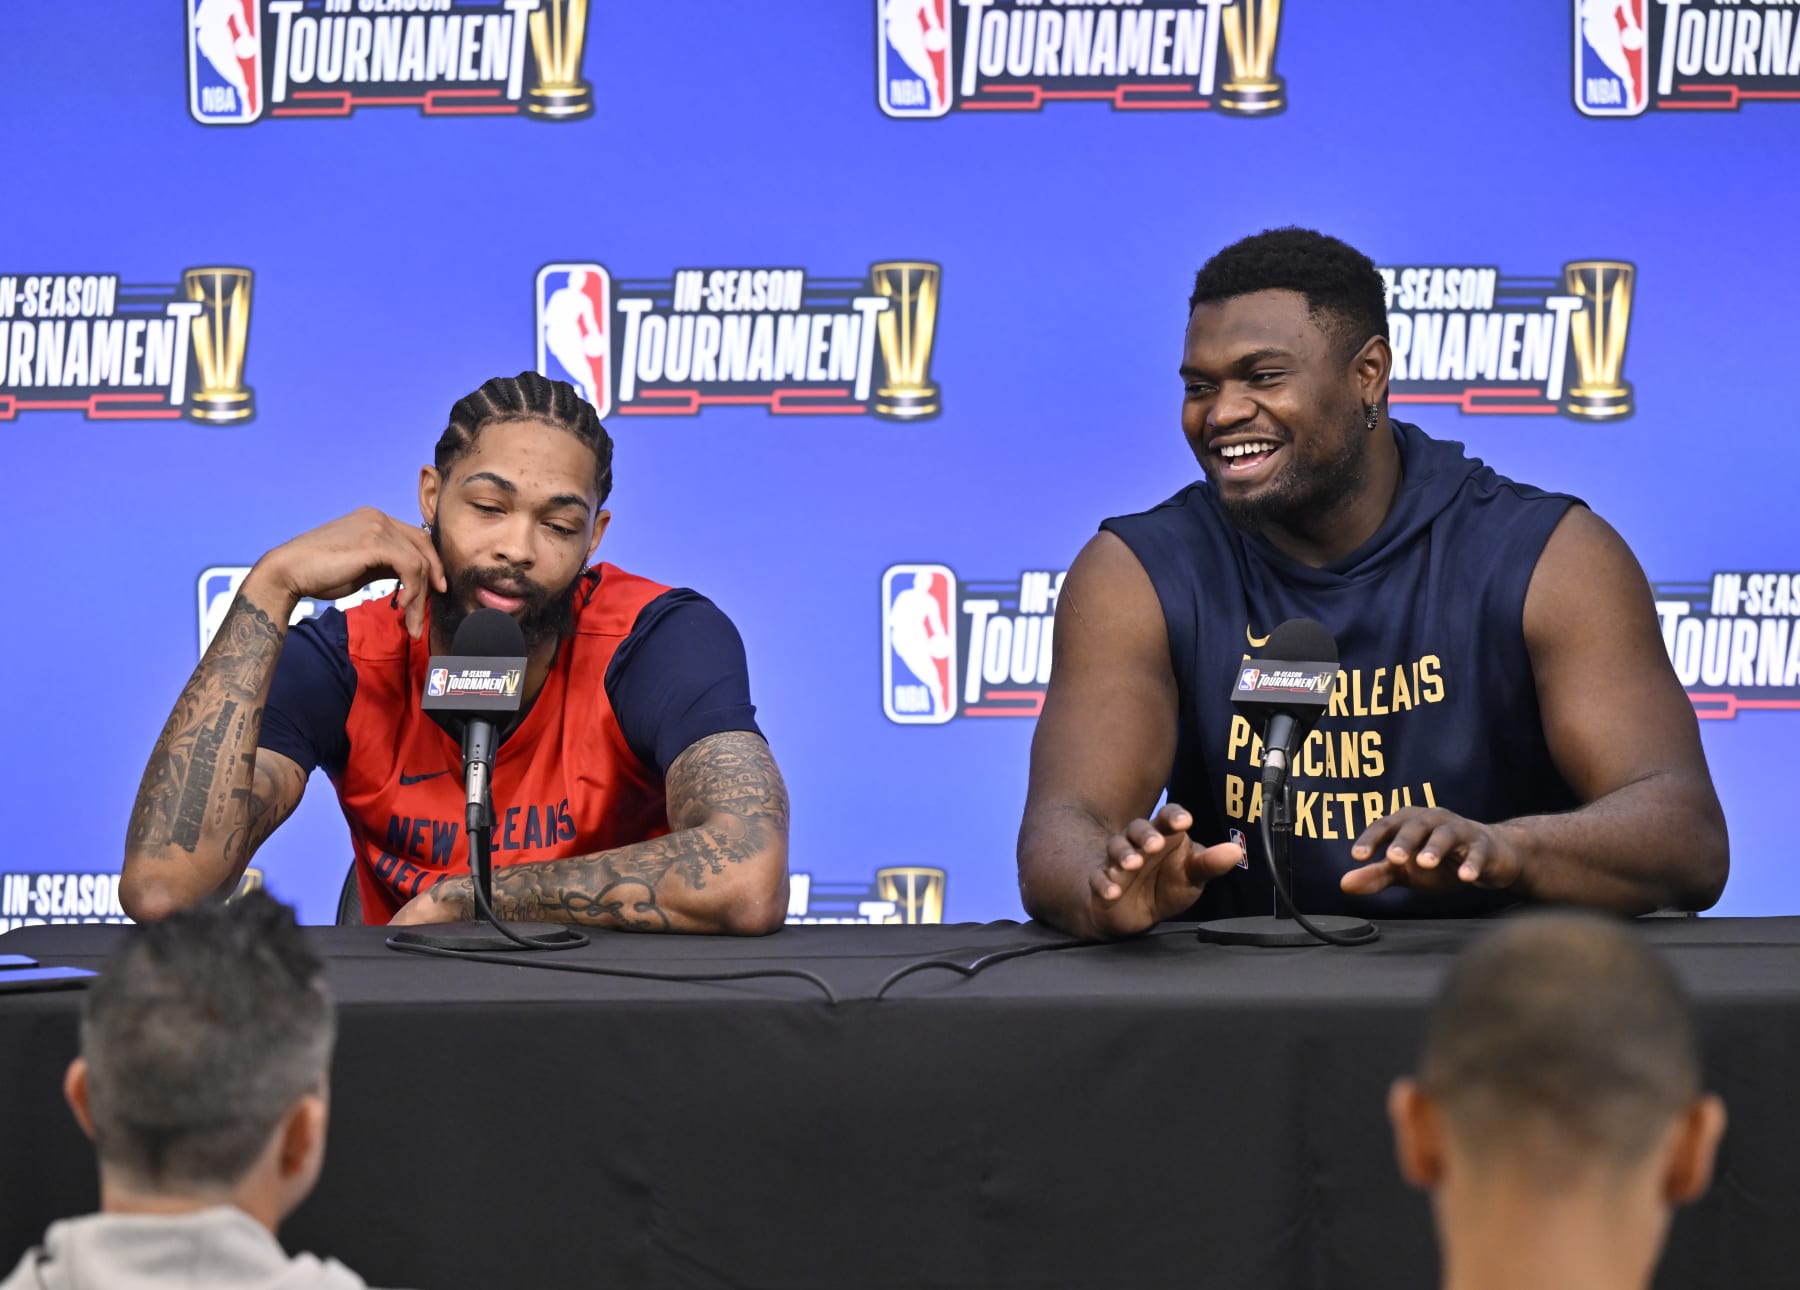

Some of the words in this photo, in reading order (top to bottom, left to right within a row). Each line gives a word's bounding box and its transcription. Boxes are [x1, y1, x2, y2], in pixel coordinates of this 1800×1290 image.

[268, 0, 540, 102] TOURNAMENT
[958, 0, 1233, 96] TOURNAMENT
[202, 86, 236, 112] NBA
[1586, 78, 1622, 104] NBA
[0, 276, 117, 318] N-SEASON
[673, 270, 804, 312] IN-SEASON
[617, 298, 889, 401] TOURNAMENT
[446, 674, 508, 693] TOURNAMENT
[1257, 673, 1320, 691] TOURNAMENT
[385, 815, 459, 867] NEW
